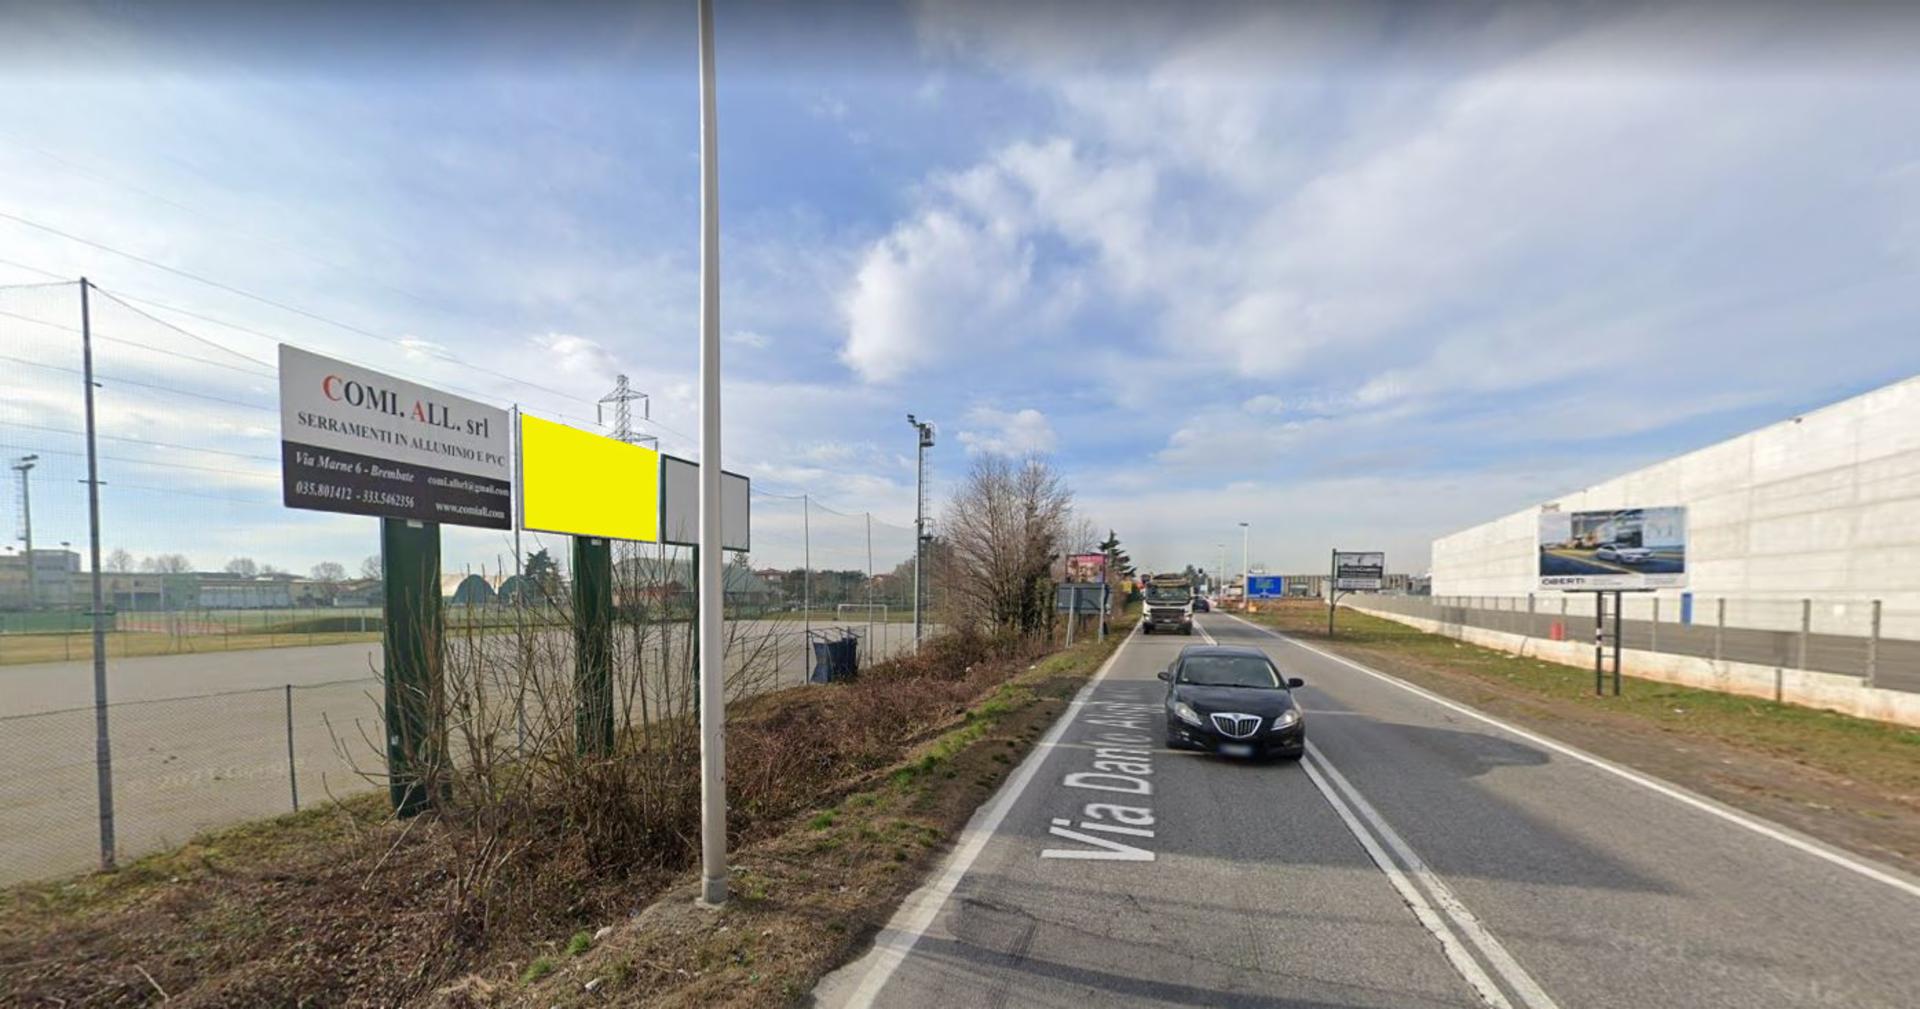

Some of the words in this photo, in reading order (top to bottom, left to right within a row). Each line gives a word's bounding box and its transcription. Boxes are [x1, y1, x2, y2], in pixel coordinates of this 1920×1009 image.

[323, 375, 405, 418] COMI.
[410, 400, 461, 431] ALL.
[466, 417, 489, 439] srl
[297, 411, 392, 445] SERRAMENTI
[395, 432, 408, 446] IN
[410, 437, 475, 461] ALLUMINIO
[477, 450, 485, 463] E
[485, 452, 506, 467] PVC
[296, 451, 315, 467] Via
[317, 455, 353, 473] Marne
[354, 462, 363, 474] 6
[370, 464, 415, 483] Brembate
[296, 481, 353, 501] 035.801412
